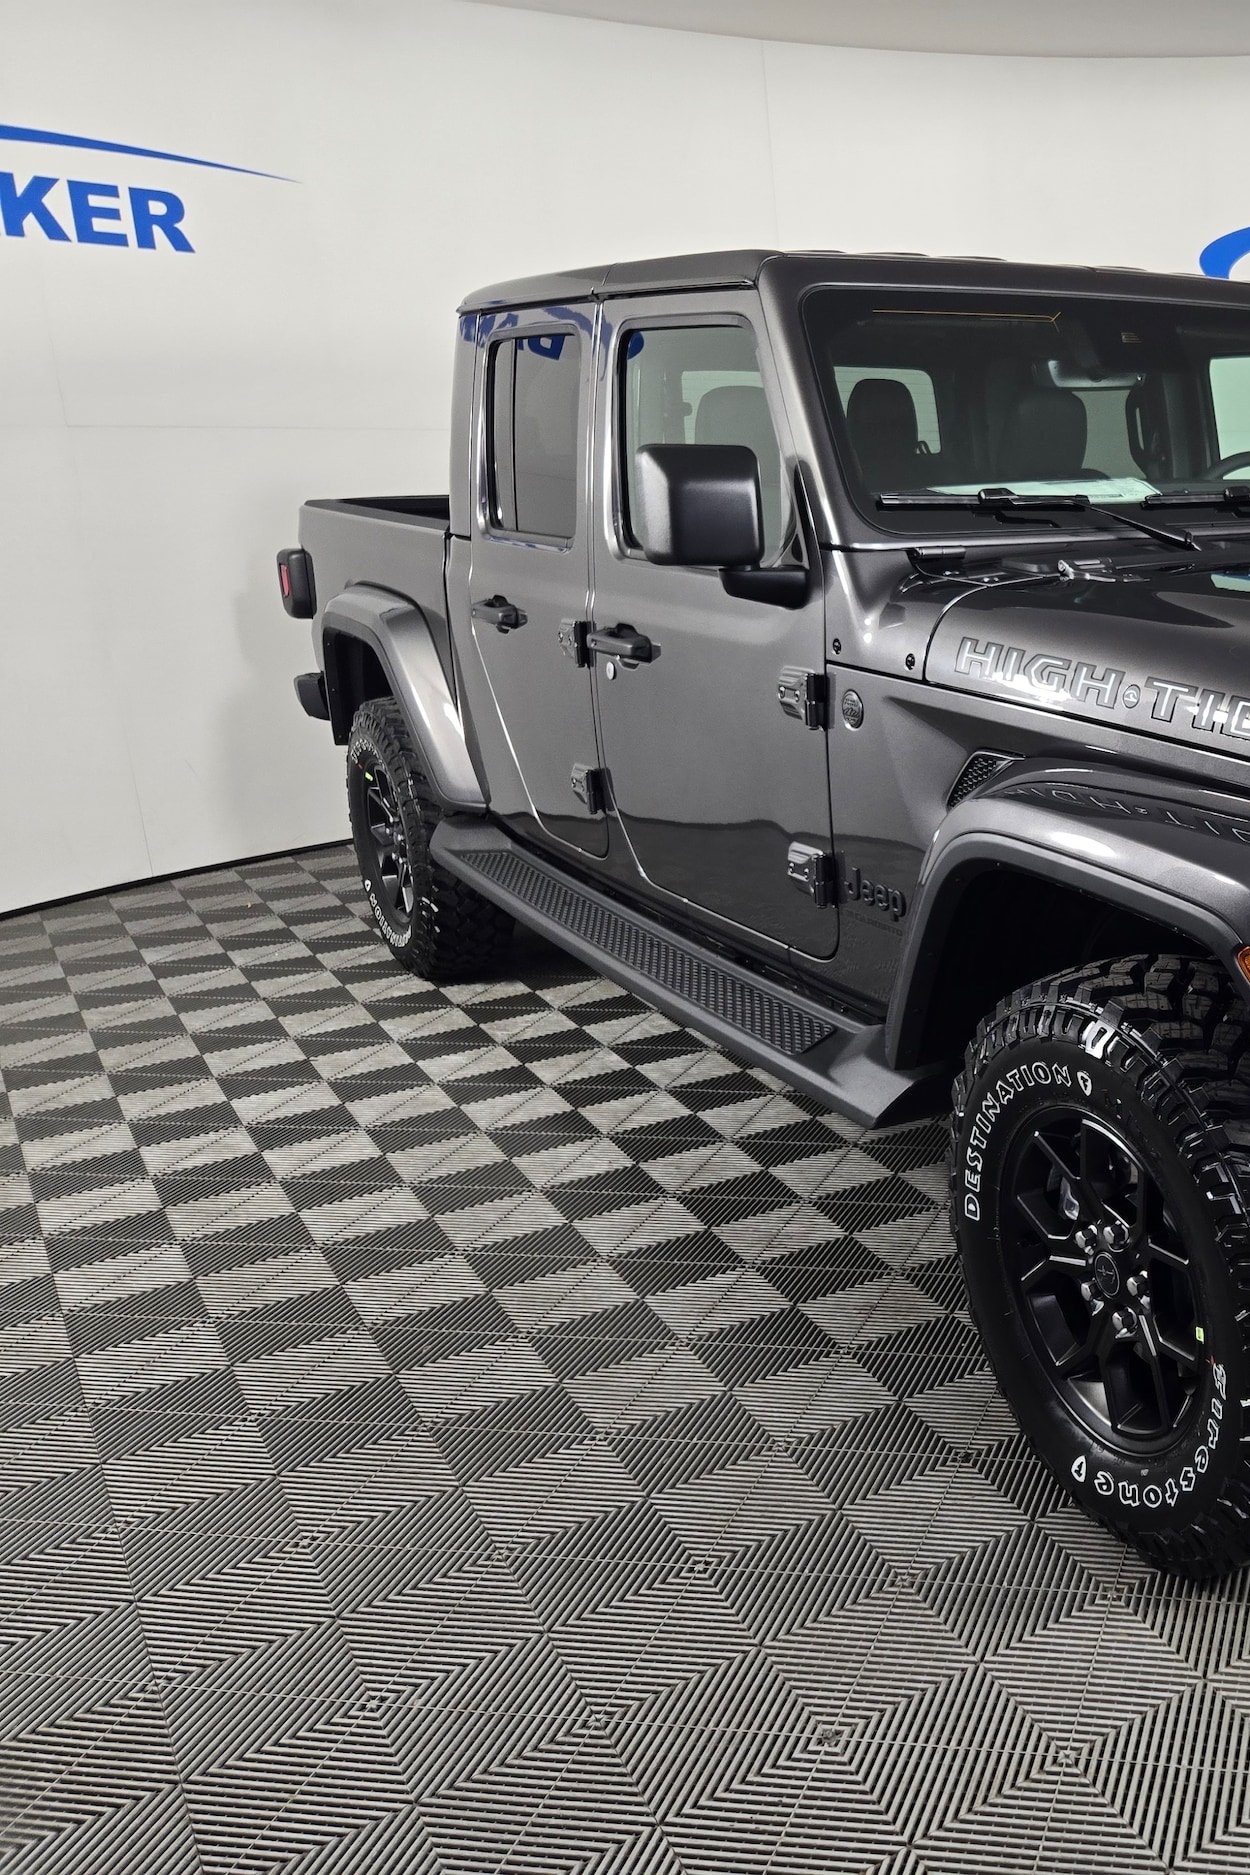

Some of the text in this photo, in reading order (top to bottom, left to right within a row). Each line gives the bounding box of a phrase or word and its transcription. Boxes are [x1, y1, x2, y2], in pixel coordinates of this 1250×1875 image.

[0, 171, 196, 254] KER
[954, 637, 1126, 709] HIGH
[844, 866, 907, 922] Jeep
[964, 1061, 1073, 1222] DESTINATION
[1094, 1363, 1227, 1508] Firestone
